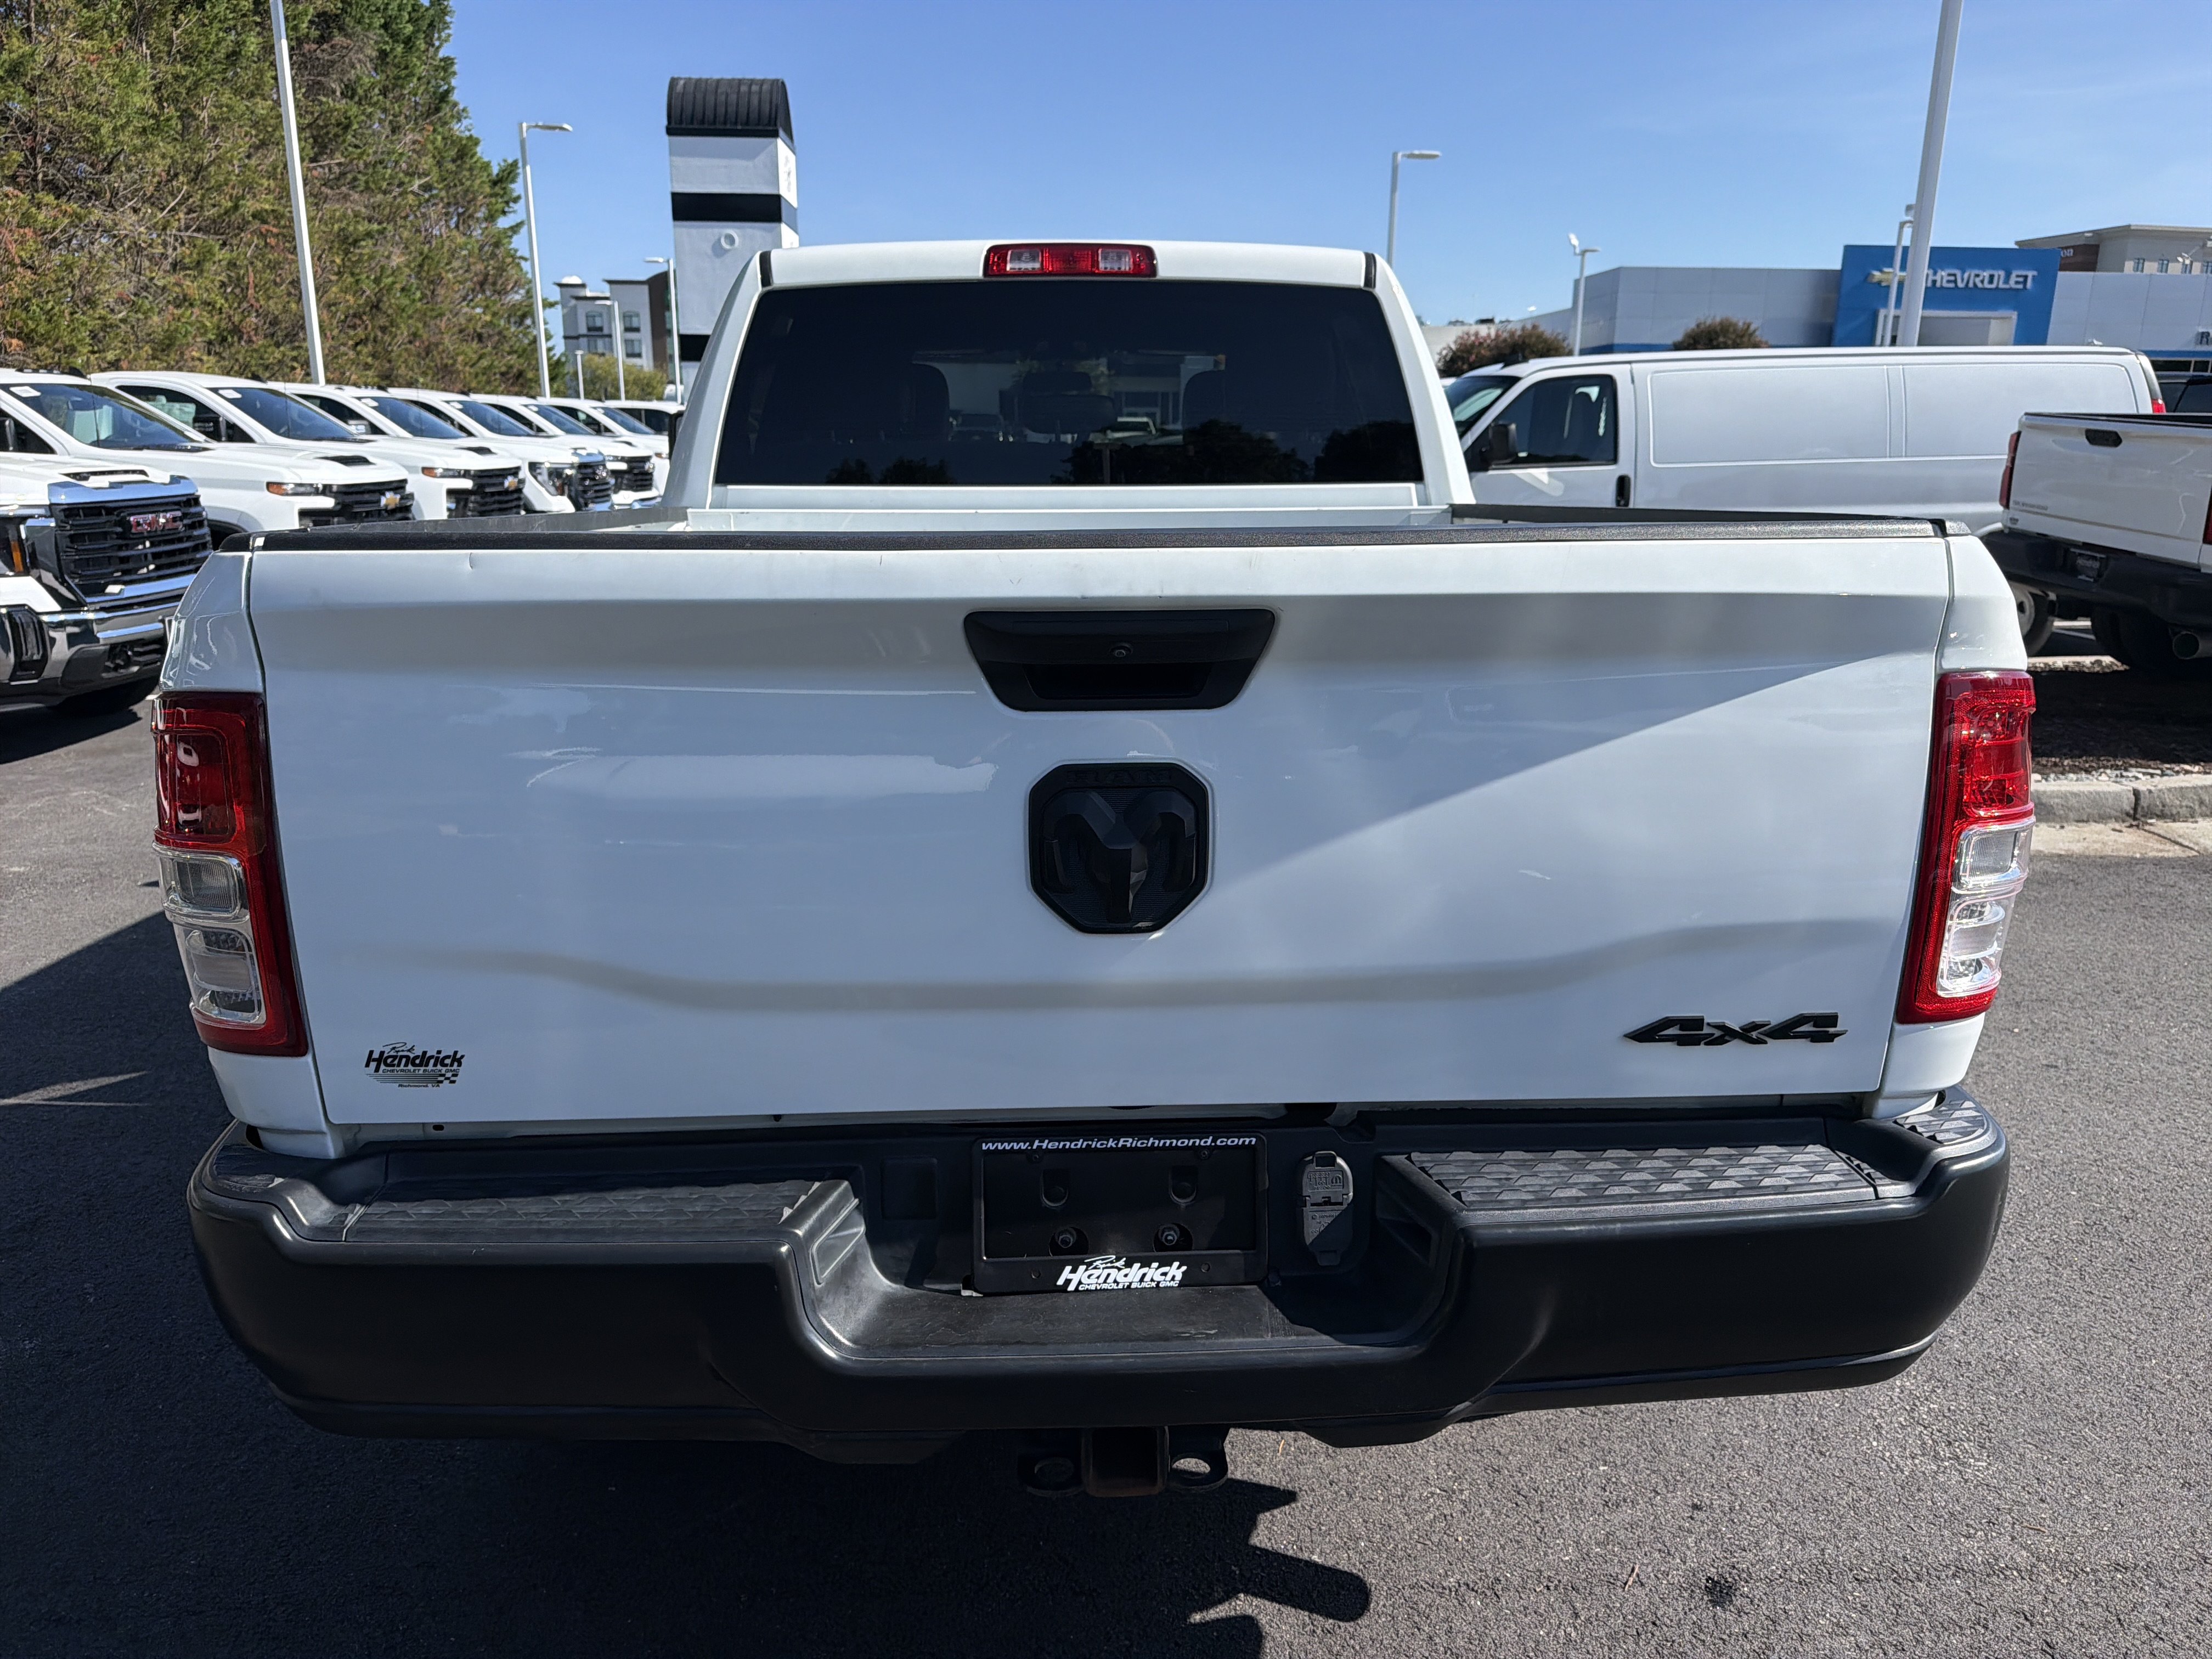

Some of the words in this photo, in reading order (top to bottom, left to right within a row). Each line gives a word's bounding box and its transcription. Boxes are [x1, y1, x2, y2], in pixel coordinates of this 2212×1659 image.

[1926, 268, 2038, 290] HEVROLET
[129, 510, 183, 533] GMC
[1066, 768, 1172, 783] RAM
[364, 1049, 466, 1073] Hendrick
[981, 1135, 1257, 1150] www.HendrickRichmond.com
[1056, 1261, 1188, 1291] Hendrick
[1077, 1282, 1129, 1290] CHEVROLET
